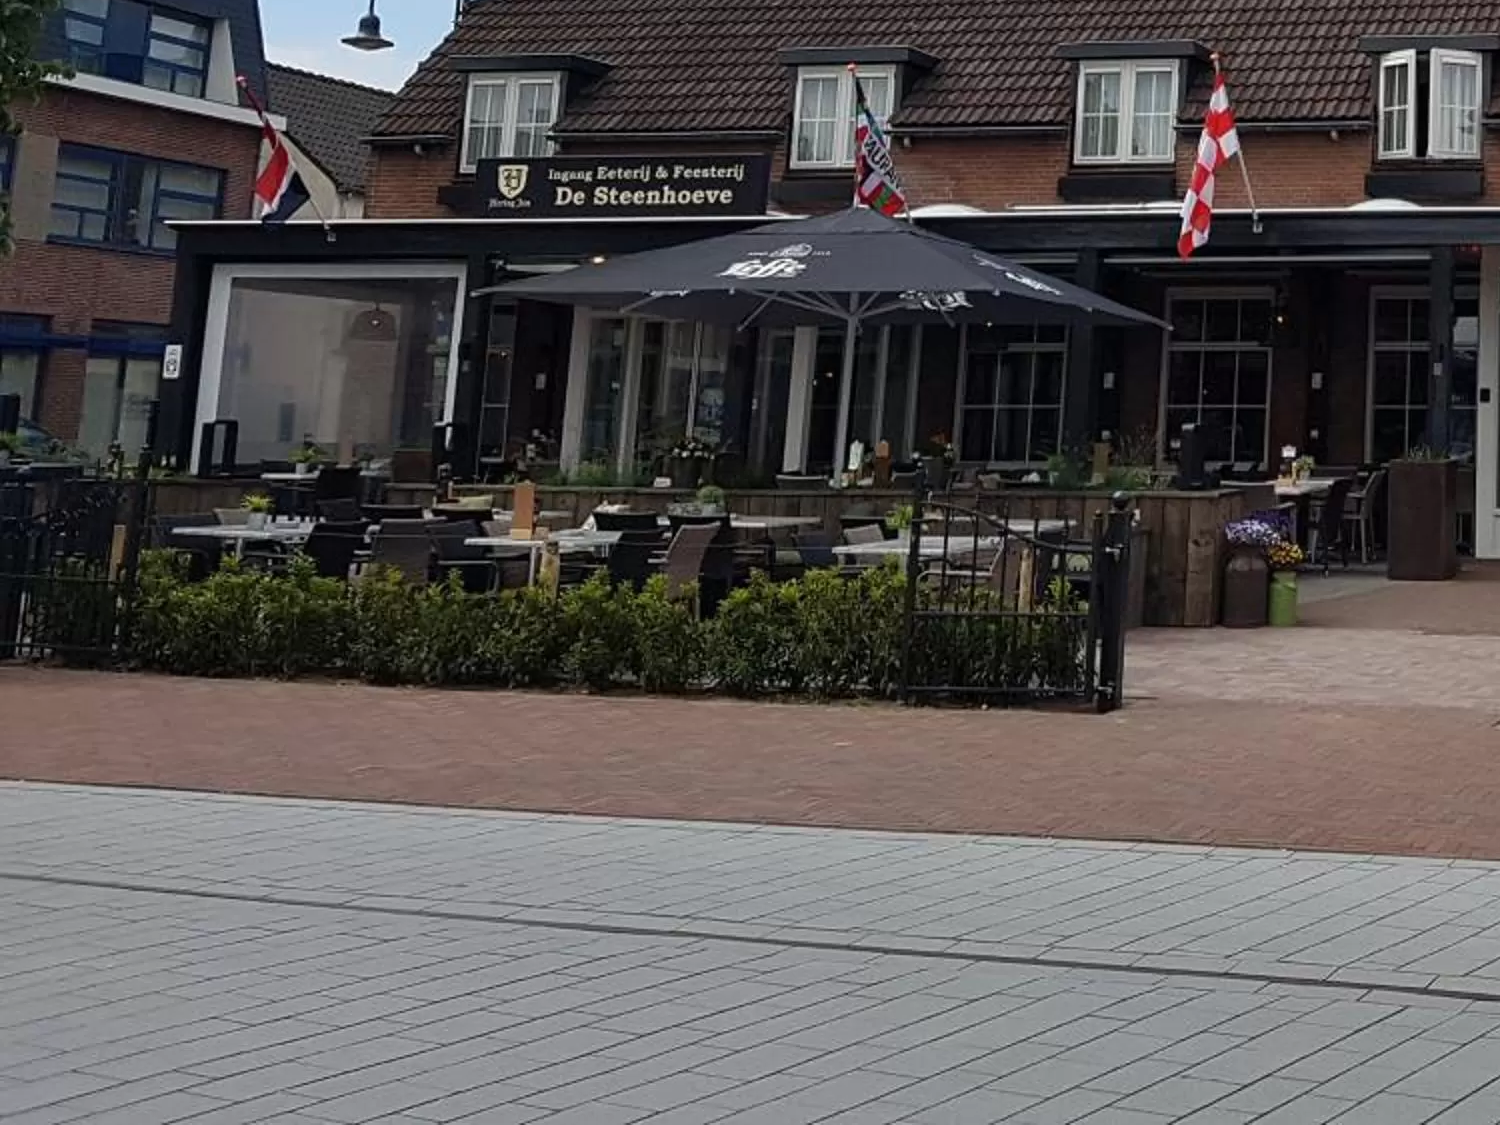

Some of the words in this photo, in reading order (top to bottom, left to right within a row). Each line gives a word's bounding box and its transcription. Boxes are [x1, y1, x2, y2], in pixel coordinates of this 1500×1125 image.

[549, 168, 593, 181] Ingang
[597, 166, 650, 181] Eeterij
[656, 166, 668, 179] &
[673, 164, 744, 180] Feesterij
[555, 187, 586, 205] De
[594, 186, 733, 205] Steenhoeve
